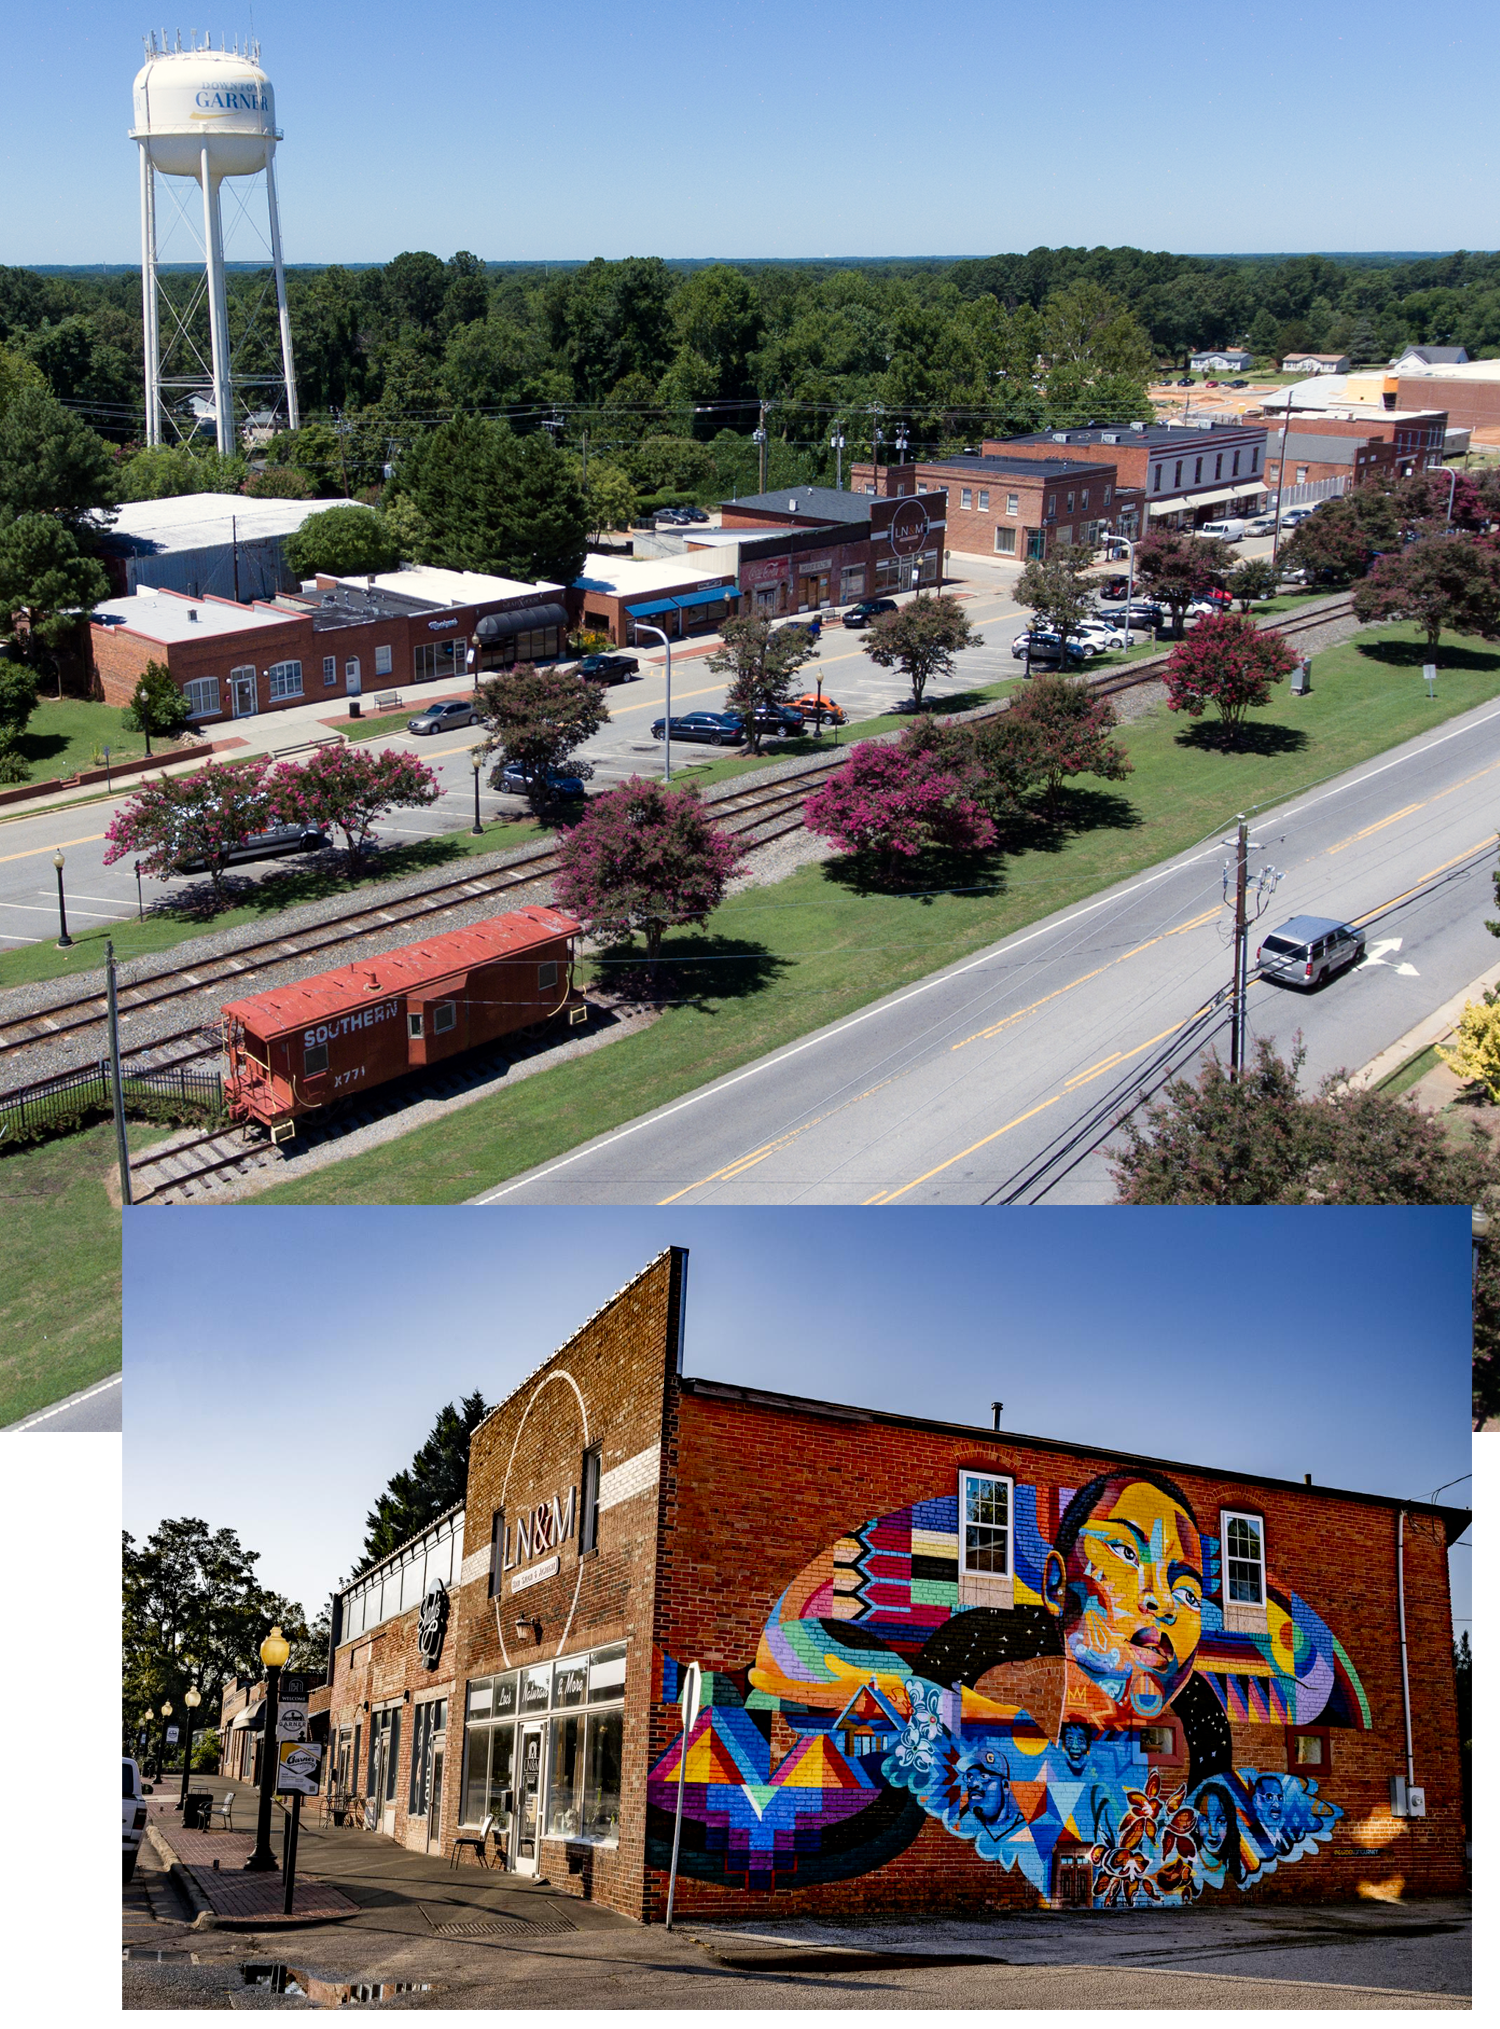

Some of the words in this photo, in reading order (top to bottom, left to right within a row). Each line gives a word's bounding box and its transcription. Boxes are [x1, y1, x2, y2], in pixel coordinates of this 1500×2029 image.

[195, 91, 269, 112] GARNER
[304, 1000, 398, 1048] SOUTHERN
[334, 1065, 366, 1088] X771
[503, 1486, 577, 1572] LN&M
[557, 1677, 564, 1695] &
[564, 1672, 584, 1695] More
